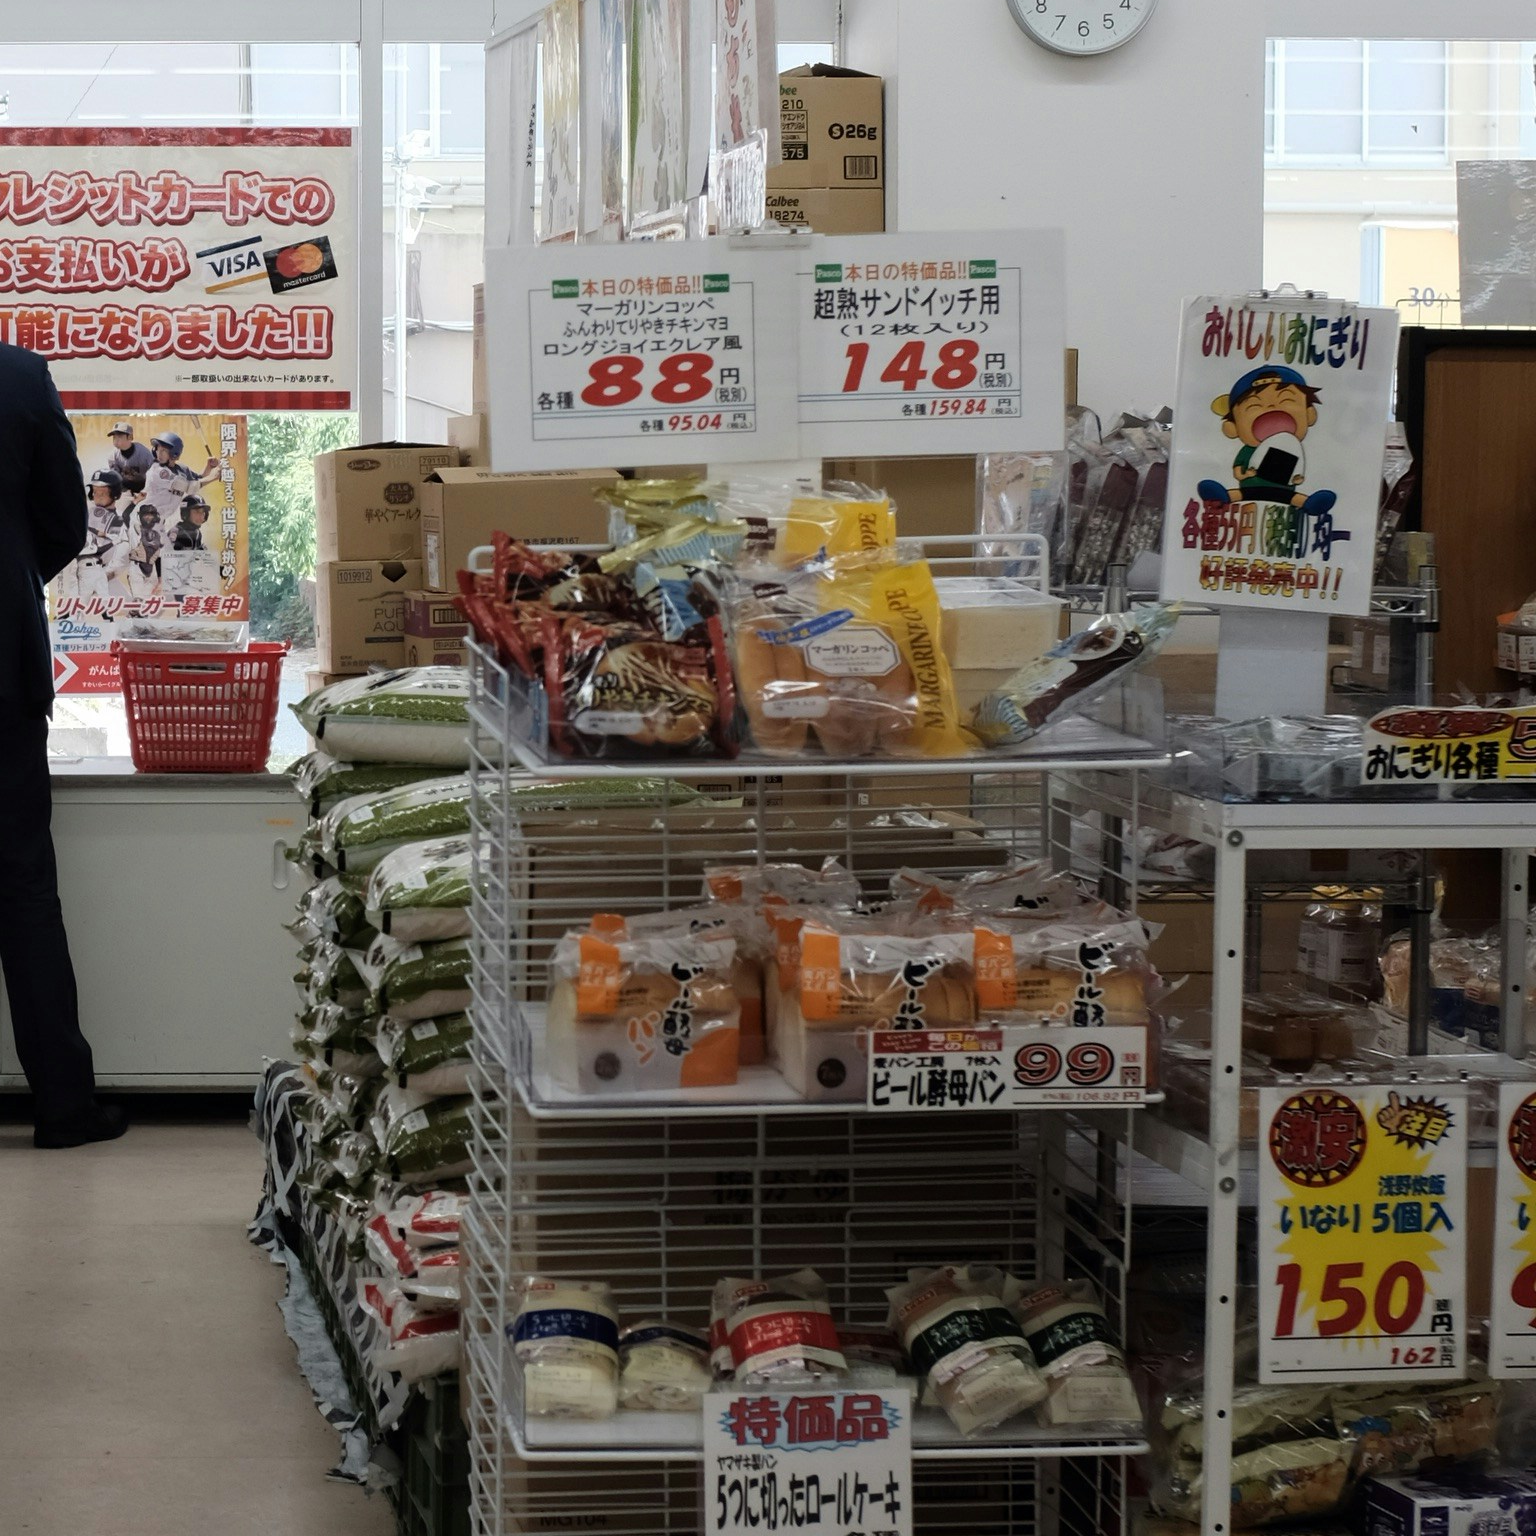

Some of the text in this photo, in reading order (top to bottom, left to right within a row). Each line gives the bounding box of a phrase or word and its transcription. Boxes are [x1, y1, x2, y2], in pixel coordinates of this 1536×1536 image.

[1055, 15, 1066, 31] 7
[1078, 21, 1090, 37] 6
[1103, 14, 1114, 29] 5
[766, 196, 799, 206] Calbee
[210, 250, 262, 279] VISA
[283, 271, 326, 289] mastercard
[577, 297, 715, 316] マーガリンコッペ
[814, 285, 1000, 320] 超熟サンドイッチ用
[563, 317, 729, 338] ふんわりてりやきチキンマヨ
[1202, 305, 1370, 370] おいしいおにぎり
[544, 335, 743, 356] ロングジョイエクレア風
[842, 339, 1005, 393] 148 円
[537, 353, 740, 410] 各種 88 円
[902, 404, 927, 417] 各種
[929, 399, 987, 416] 159.84
[640, 419, 664, 432] 各種
[668, 414, 722, 430] 95.04
[1199, 554, 1343, 601] 好評発売中!!
[56, 595, 244, 617] リトルリーガー募集中
[810, 643, 891, 656] マーガリンコッペ
[1365, 740, 1501, 780] おにぎり各種
[1014, 1043, 1115, 1086] 99
[872, 1069, 1006, 1108] ビール酵母パン
[1399, 1112, 1449, 1141] 注目
[1280, 1201, 1454, 1234] いなり 5個入
[1275, 1260, 1454, 1337] 150 円
[1390, 1347, 1437, 1365] 162
[729, 1394, 889, 1445] 特価品
[716, 1470, 902, 1531] 5つに切ったロールケーキ
